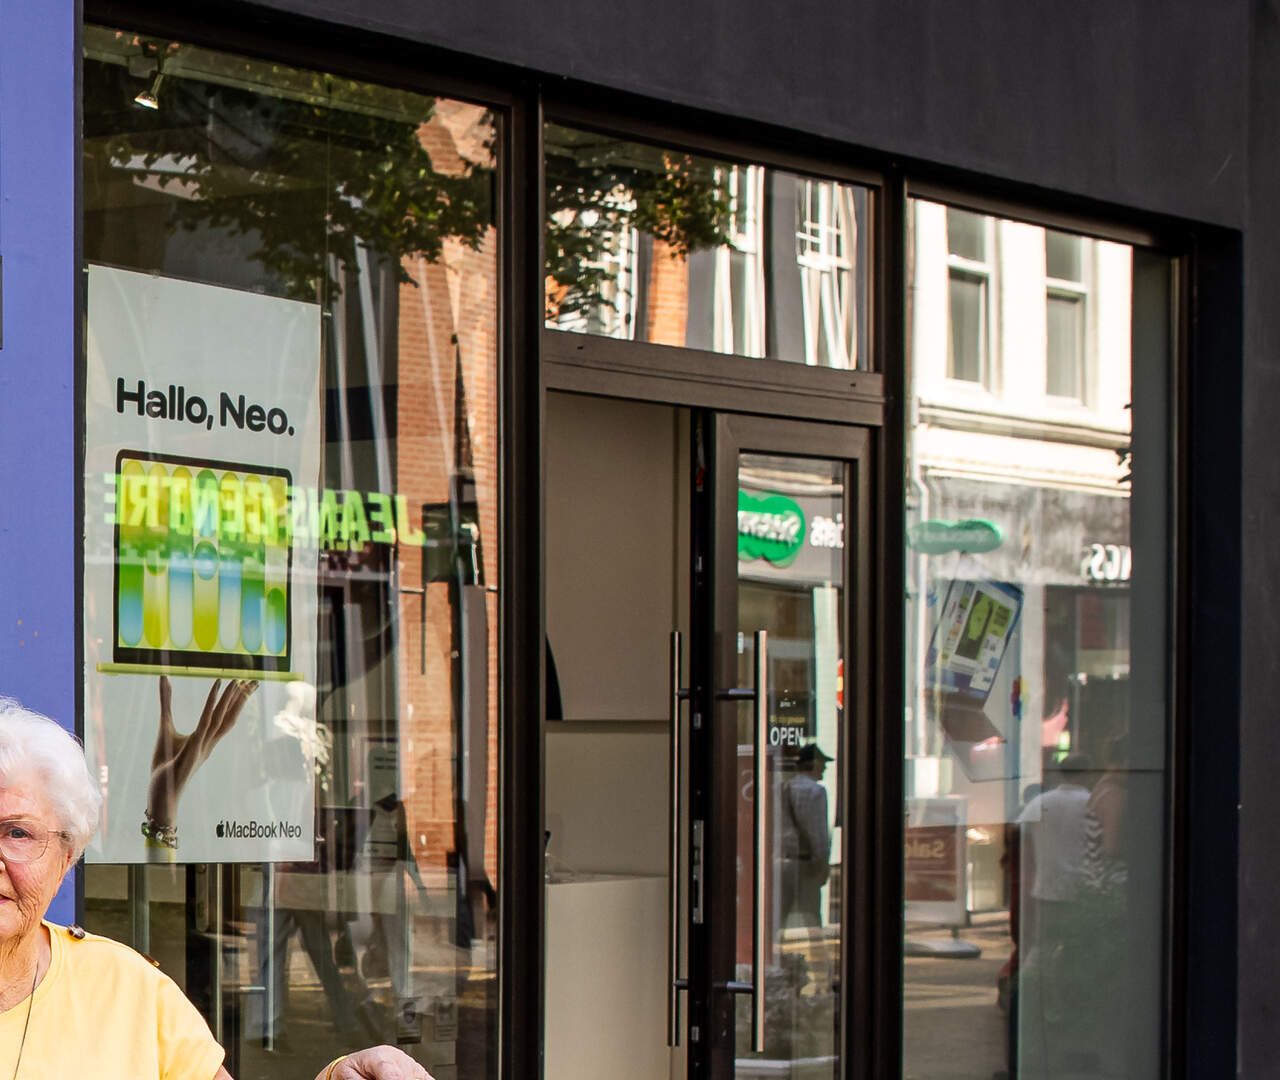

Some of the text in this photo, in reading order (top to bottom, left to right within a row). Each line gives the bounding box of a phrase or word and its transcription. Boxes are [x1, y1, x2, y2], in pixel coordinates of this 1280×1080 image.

[116, 377, 294, 436] Hallo, Neo.
[769, 727, 804, 746] OPEN
[225, 821, 301, 838] MacBook Neo
